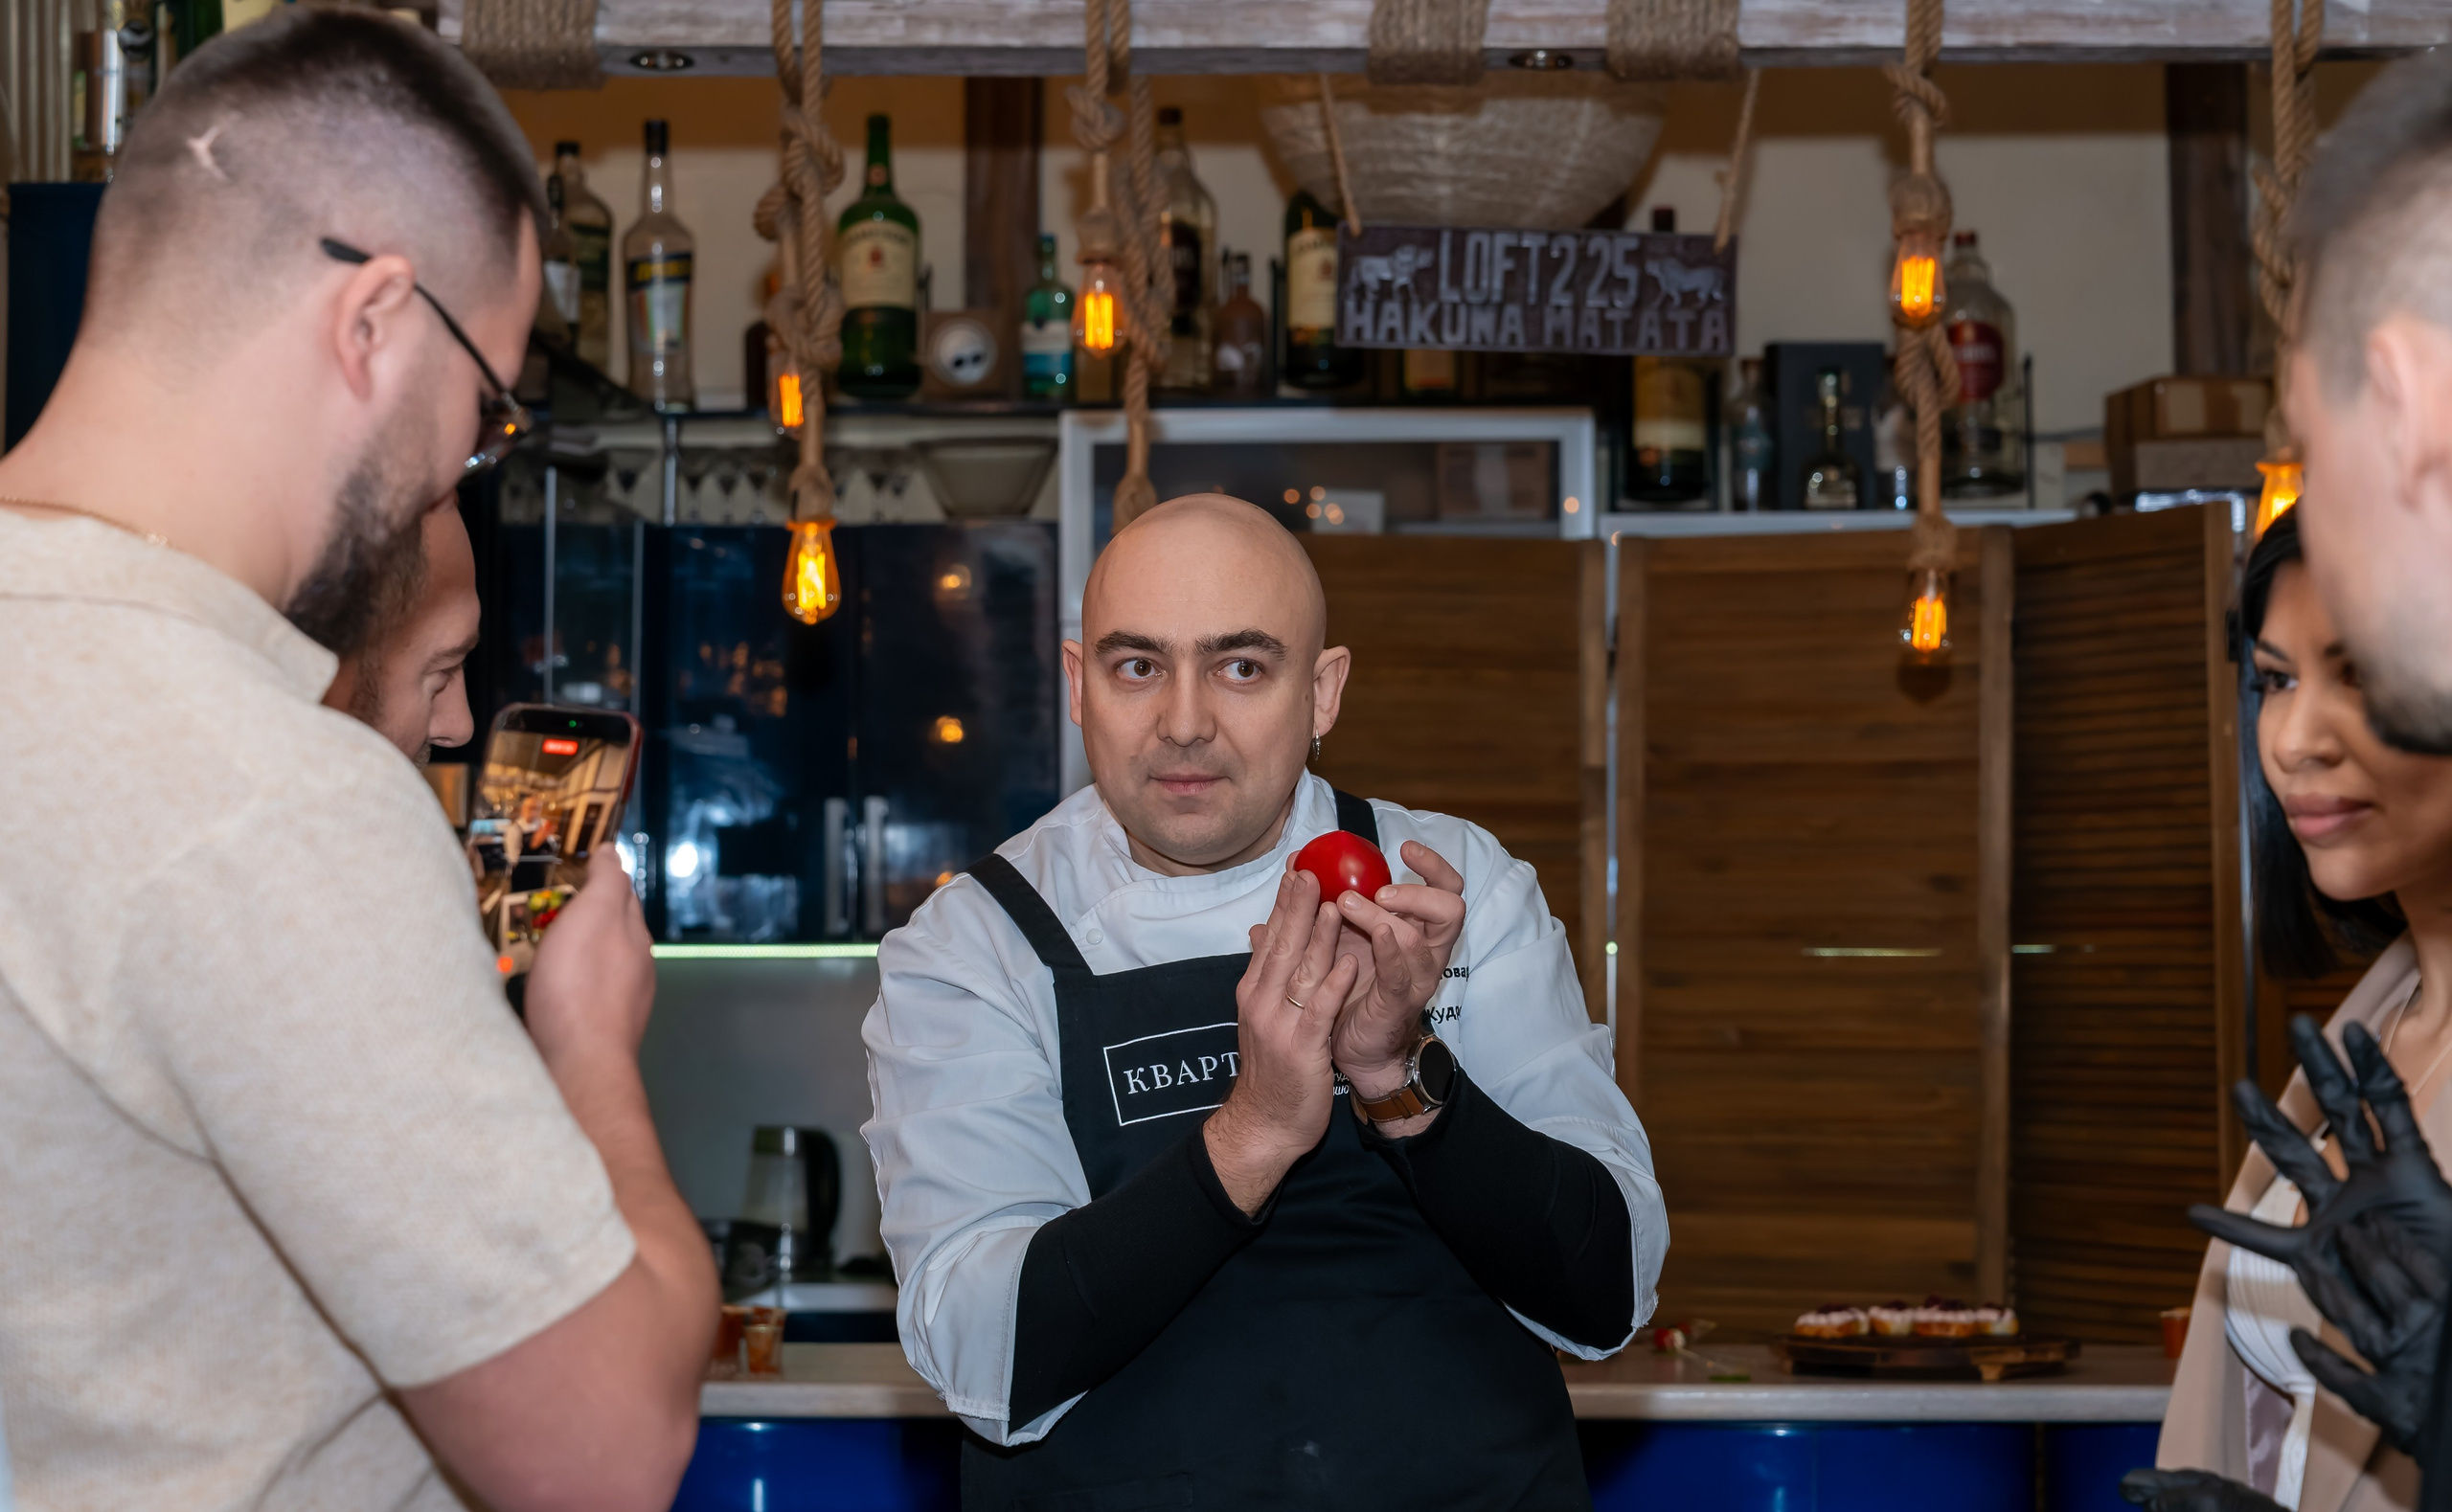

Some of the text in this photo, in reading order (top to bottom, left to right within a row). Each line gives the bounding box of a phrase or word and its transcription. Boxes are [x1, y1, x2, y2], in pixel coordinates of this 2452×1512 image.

[1344, 299, 1728, 352] HAKUNA MATATA
[1440, 965, 1469, 982] ова
[1123, 1051, 1240, 1095] КВАРТ
